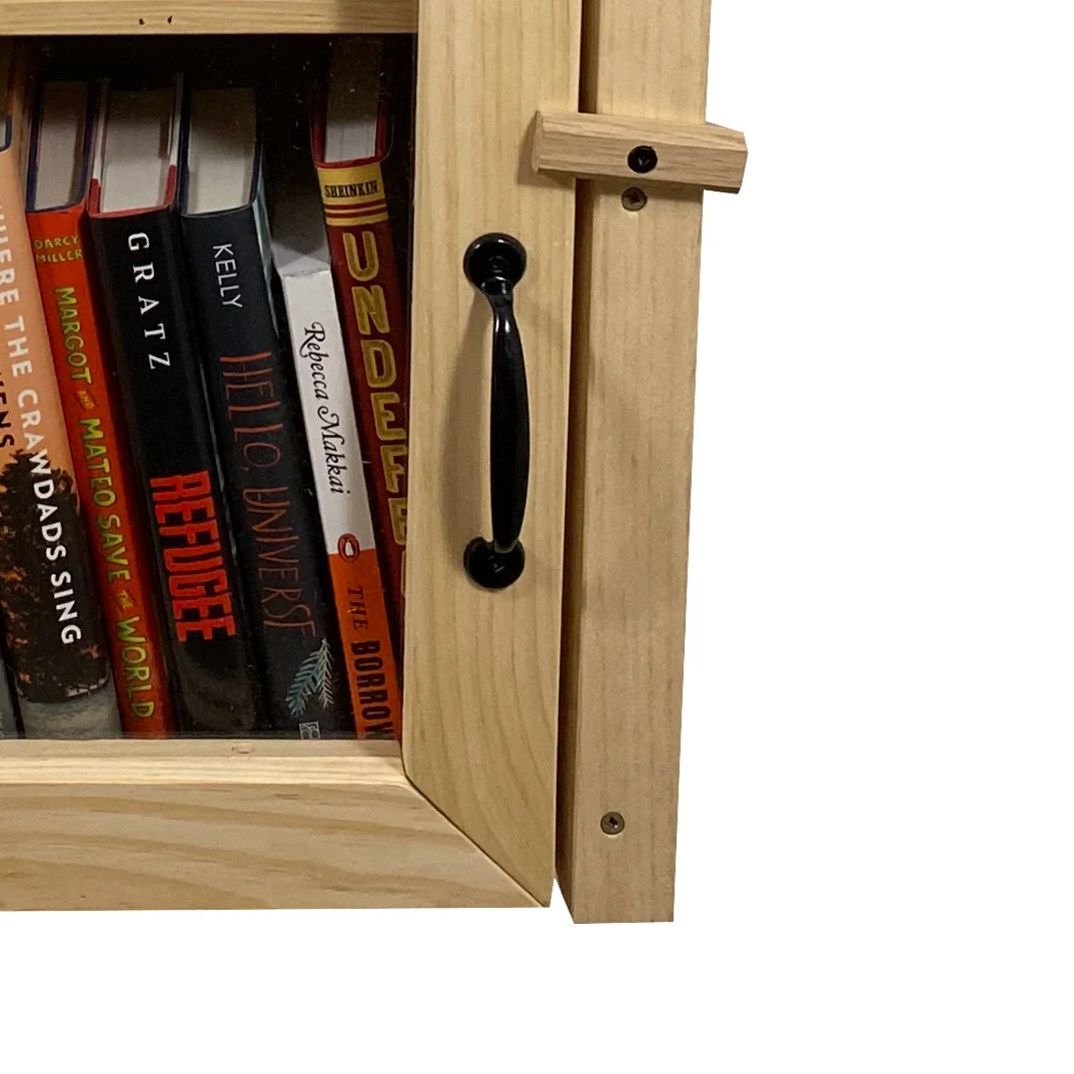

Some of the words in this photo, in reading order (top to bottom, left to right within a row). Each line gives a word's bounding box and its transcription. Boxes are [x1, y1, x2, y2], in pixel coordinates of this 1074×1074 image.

[34, 234, 79, 250] DARCY
[324, 181, 377, 199] SHEINKIN
[35, 248, 83, 263] MILLER
[127, 232, 171, 370] GRATZ
[213, 243, 243, 309] KELLY
[4, 315, 33, 378] THE
[300, 321, 328, 399] Rebecca
[316, 404, 351, 494] Makkai
[342, 230, 408, 597] UNDEFE
[17, 389, 67, 562] CRAWDADS
[55, 286, 92, 385] MARGOT
[78, 418, 116, 507] MATEO
[97, 514, 131, 584] SAVE
[117, 616, 155, 718] WORLD
[51, 571, 82, 645] SING
[149, 469, 236, 643] REFUGEE
[243, 486, 317, 637] UNIVERSE
[346, 585, 368, 631] THE
